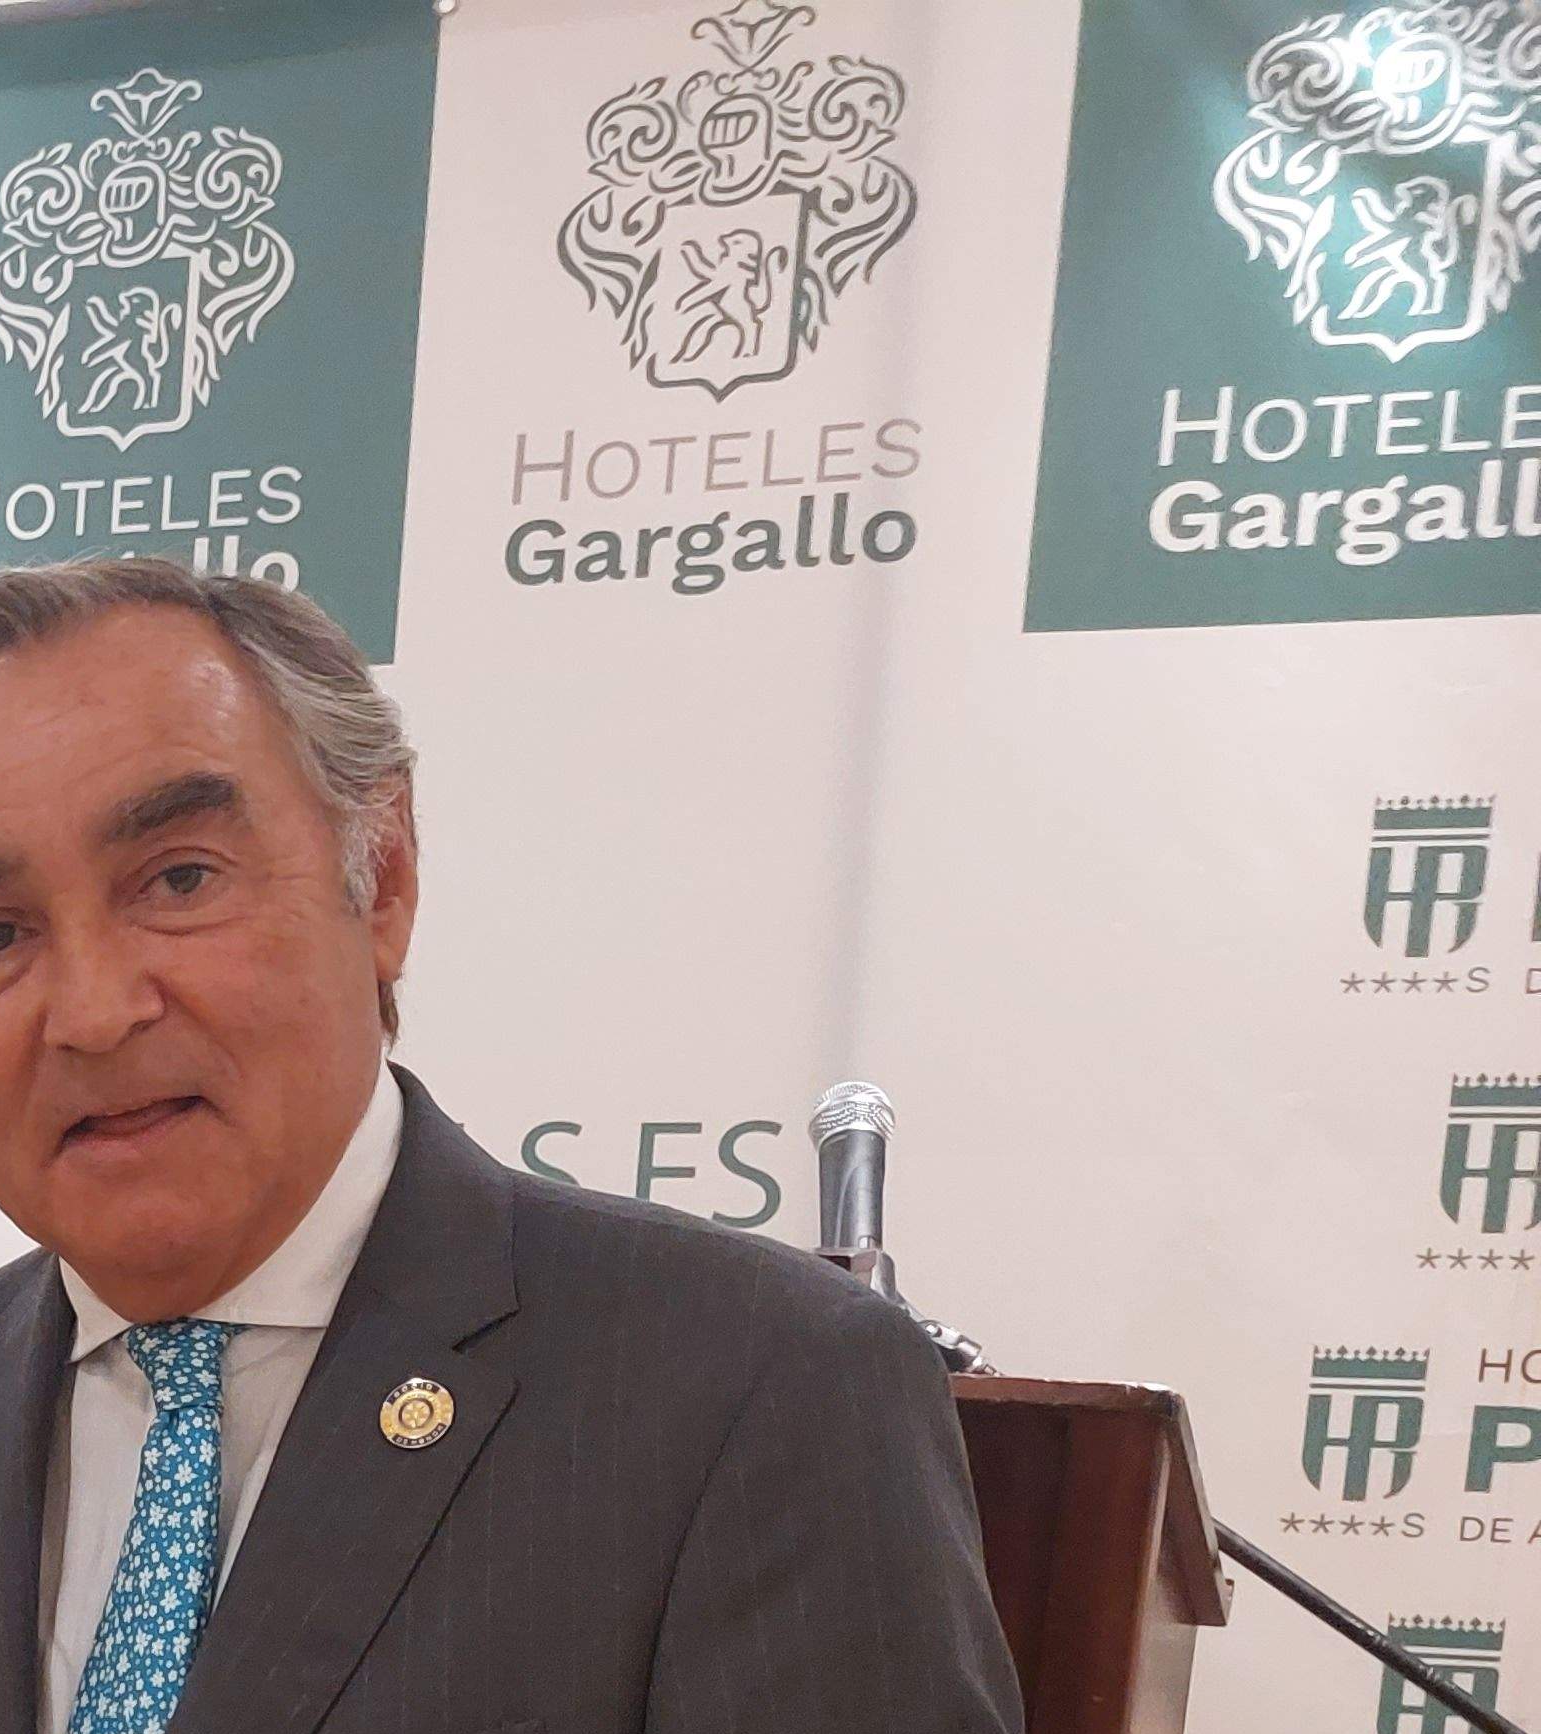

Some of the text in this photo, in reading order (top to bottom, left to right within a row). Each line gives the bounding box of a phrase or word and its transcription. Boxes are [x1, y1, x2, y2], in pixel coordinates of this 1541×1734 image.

[510, 417, 923, 507] HOTELES
[1156, 384, 1541, 468] HOTELE
[503, 490, 919, 597] Gargallo
[1148, 456, 1541, 567] Gargall
[1458, 1515, 1515, 1545] DE
